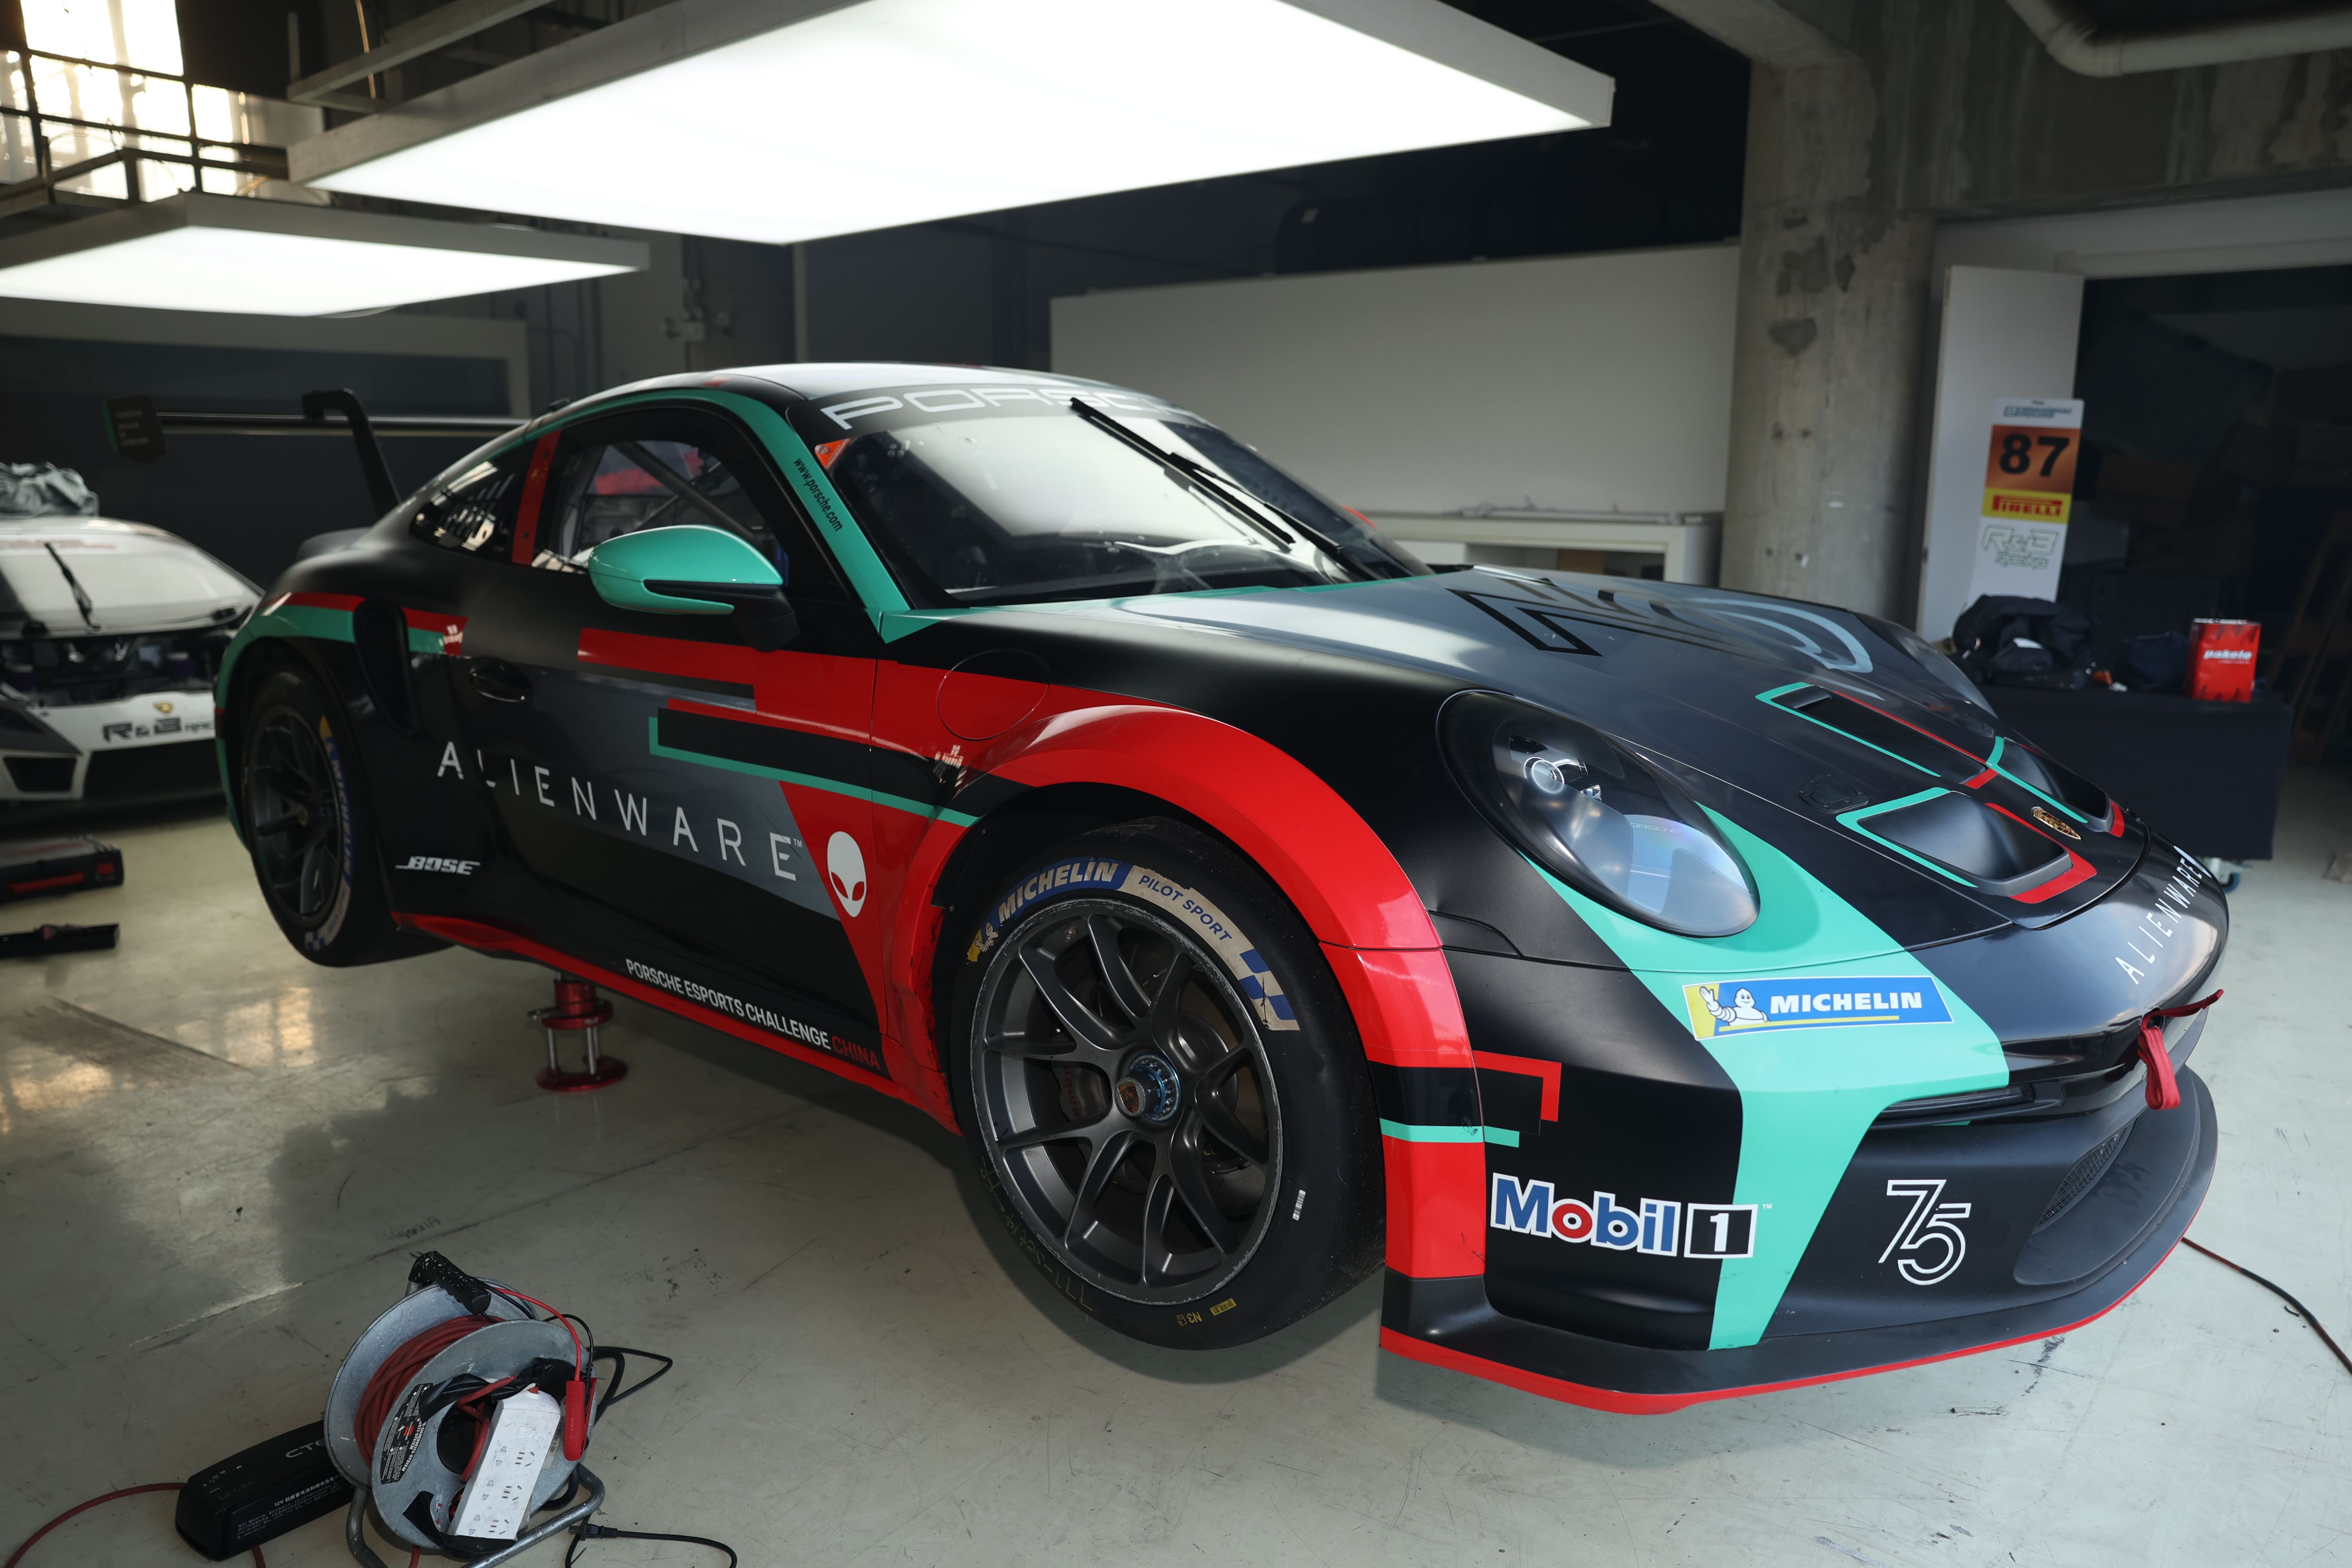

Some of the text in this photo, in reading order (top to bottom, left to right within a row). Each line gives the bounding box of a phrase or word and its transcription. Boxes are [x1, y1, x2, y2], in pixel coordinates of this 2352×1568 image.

[1999, 433, 2070, 478] 87
[794, 457, 842, 532] www.porsche.com
[1992, 495, 2062, 517] PIRELLI
[437, 741, 796, 881] ALIENWARE
[396, 855, 481, 875] BOSE
[998, 861, 1118, 924] MICHELIN
[1138, 875, 1232, 942] PILOT SPORT
[2116, 858, 2203, 985] ALIENWARE
[626, 959, 882, 1070] PORSCHE ESPORTS CHALLENGE CHINA
[1770, 992, 1922, 1014] MICHELIN
[1490, 1173, 1681, 1257] Mobil
[1878, 1179, 1972, 1285] 75
[285, 1439, 326, 1458] CTE
